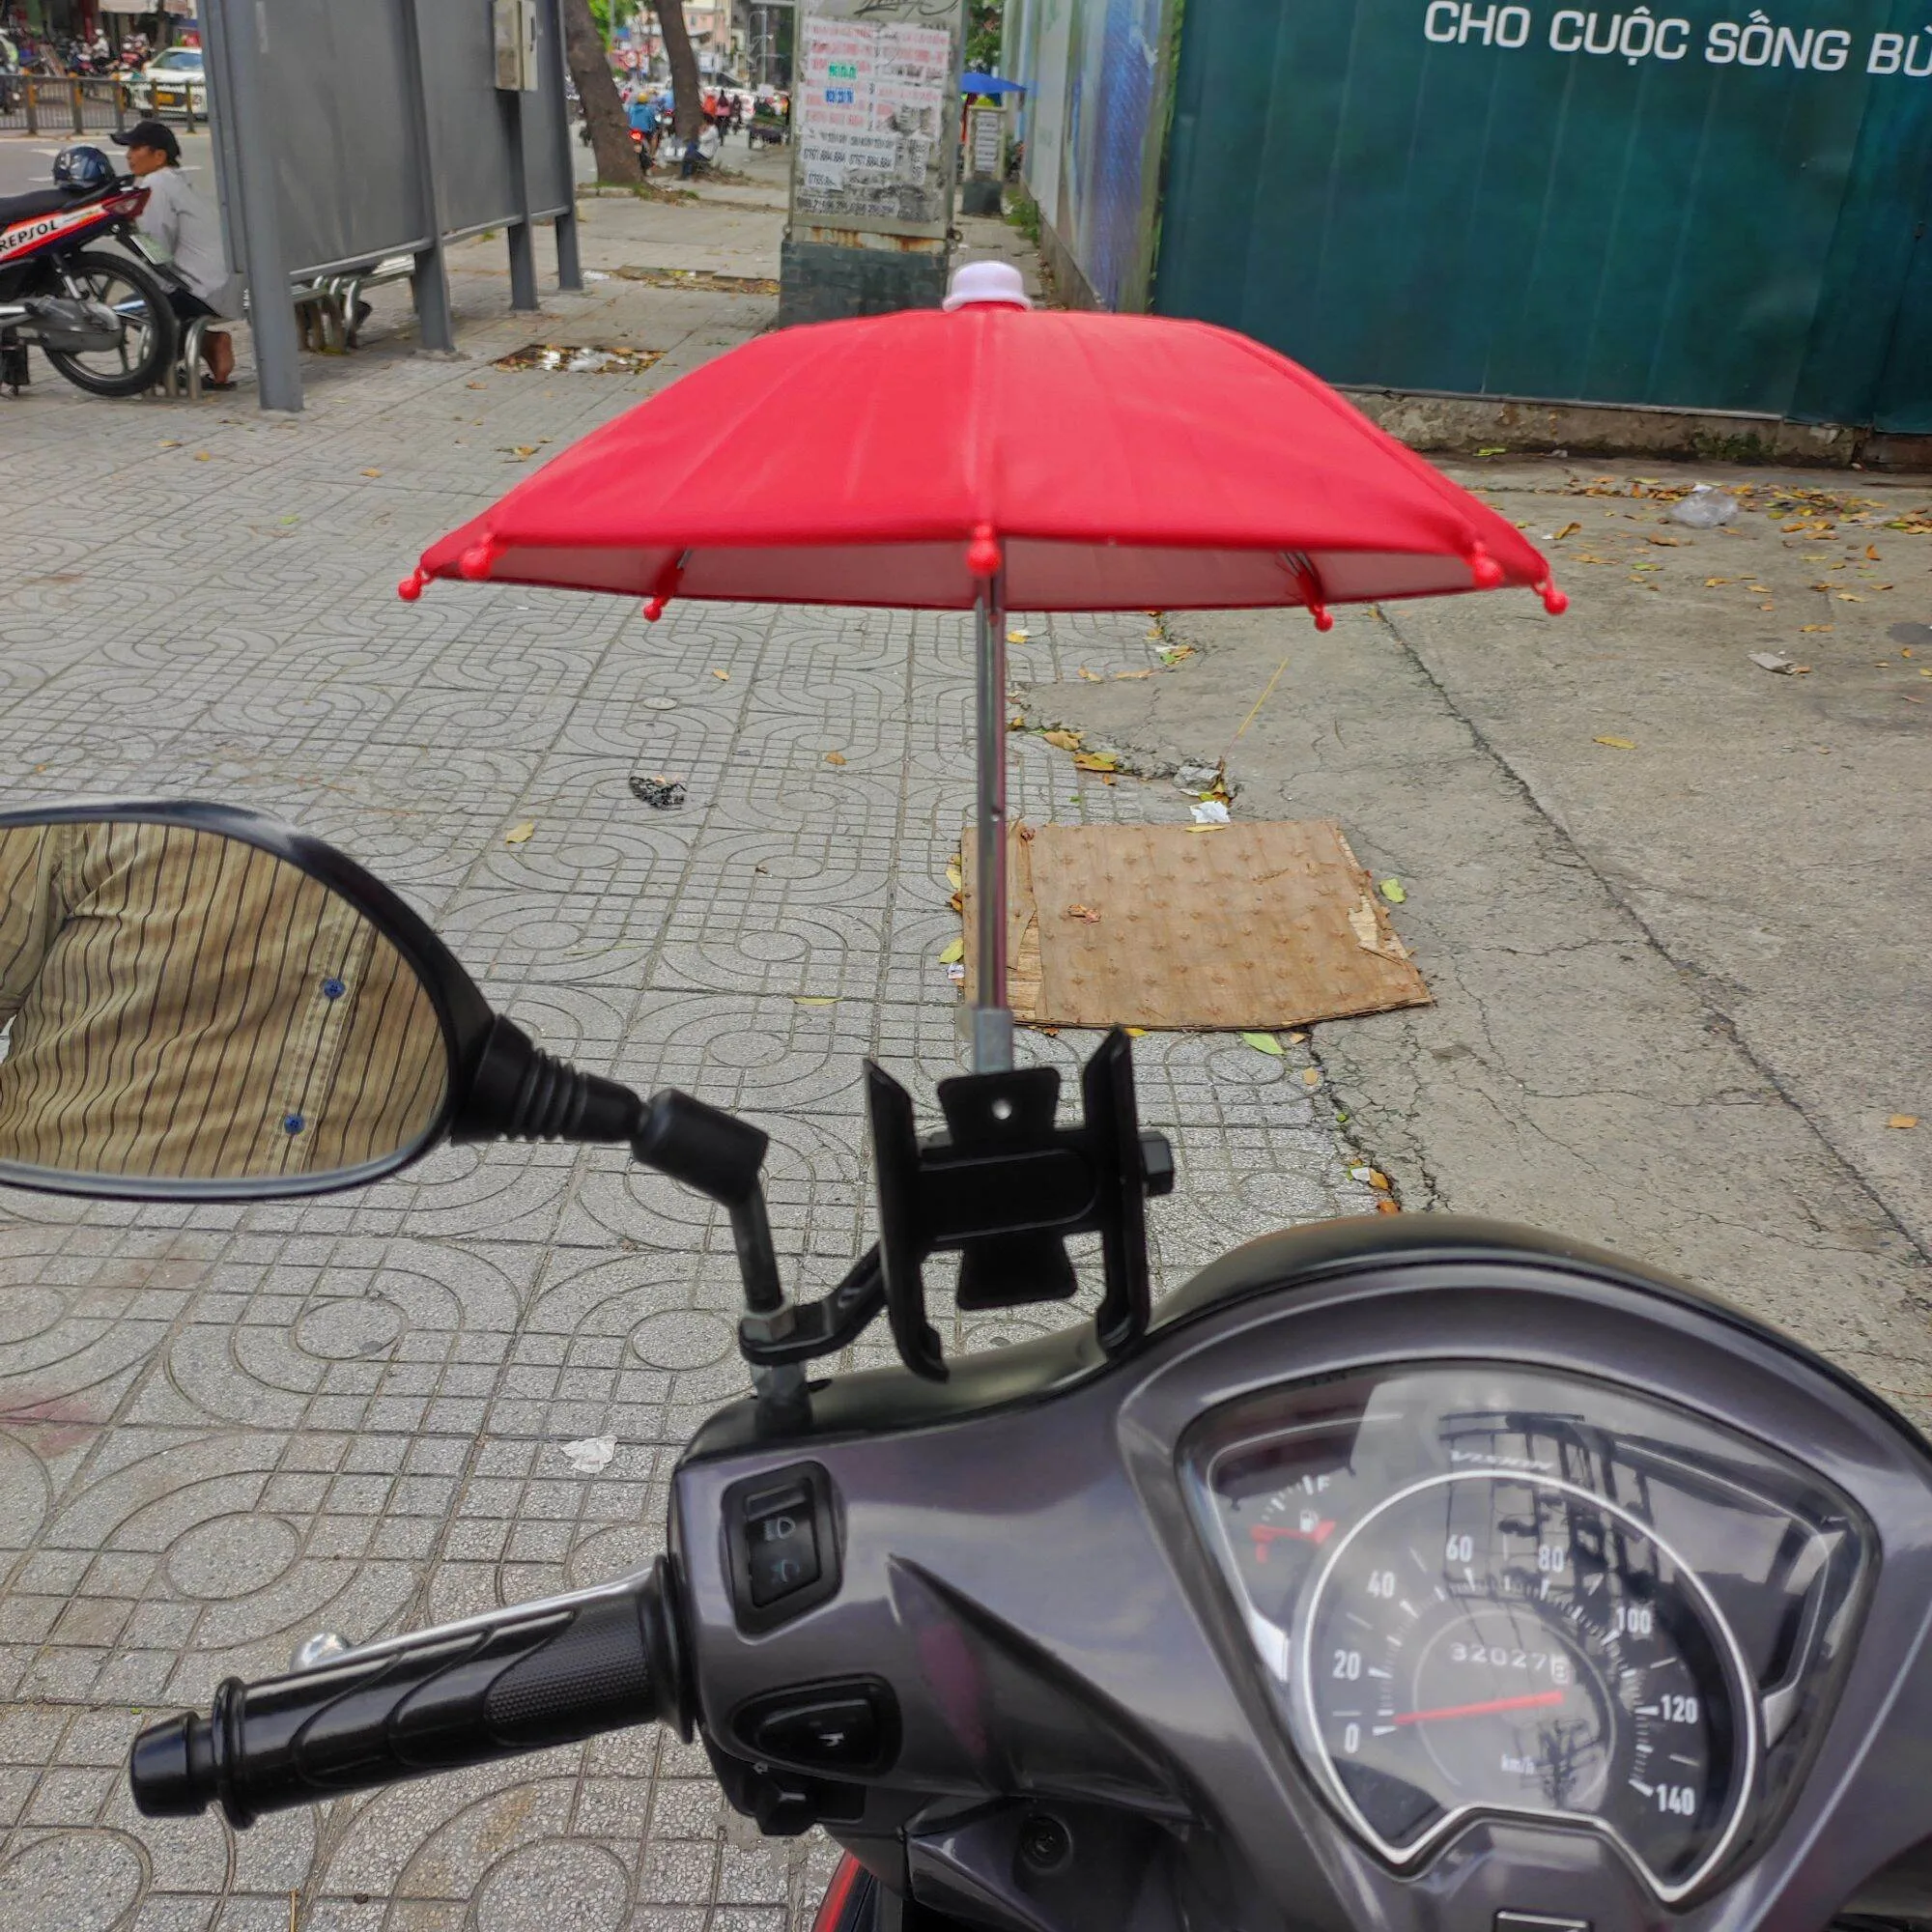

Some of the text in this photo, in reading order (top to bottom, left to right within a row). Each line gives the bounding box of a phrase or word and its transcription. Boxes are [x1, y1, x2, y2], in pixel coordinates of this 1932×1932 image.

[1424, 1, 1532, 48] CHO
[1548, 6, 1690, 67] CUỘC
[1704, 10, 1852, 72] SỐNG
[0, 219, 59, 251] REPSOL
[1317, 1475, 1330, 1492] F
[1445, 1534, 1473, 1563] 60
[1538, 1544, 1565, 1574] 80
[1368, 1570, 1396, 1599] 40
[1616, 1606, 1653, 1634] 100
[1332, 1649, 1362, 1681] 20
[1661, 1695, 1698, 1724] 120
[1344, 1721, 1360, 1754] 0
[1501, 1753, 1535, 1776] km/h
[1657, 1784, 1695, 1815] 140
